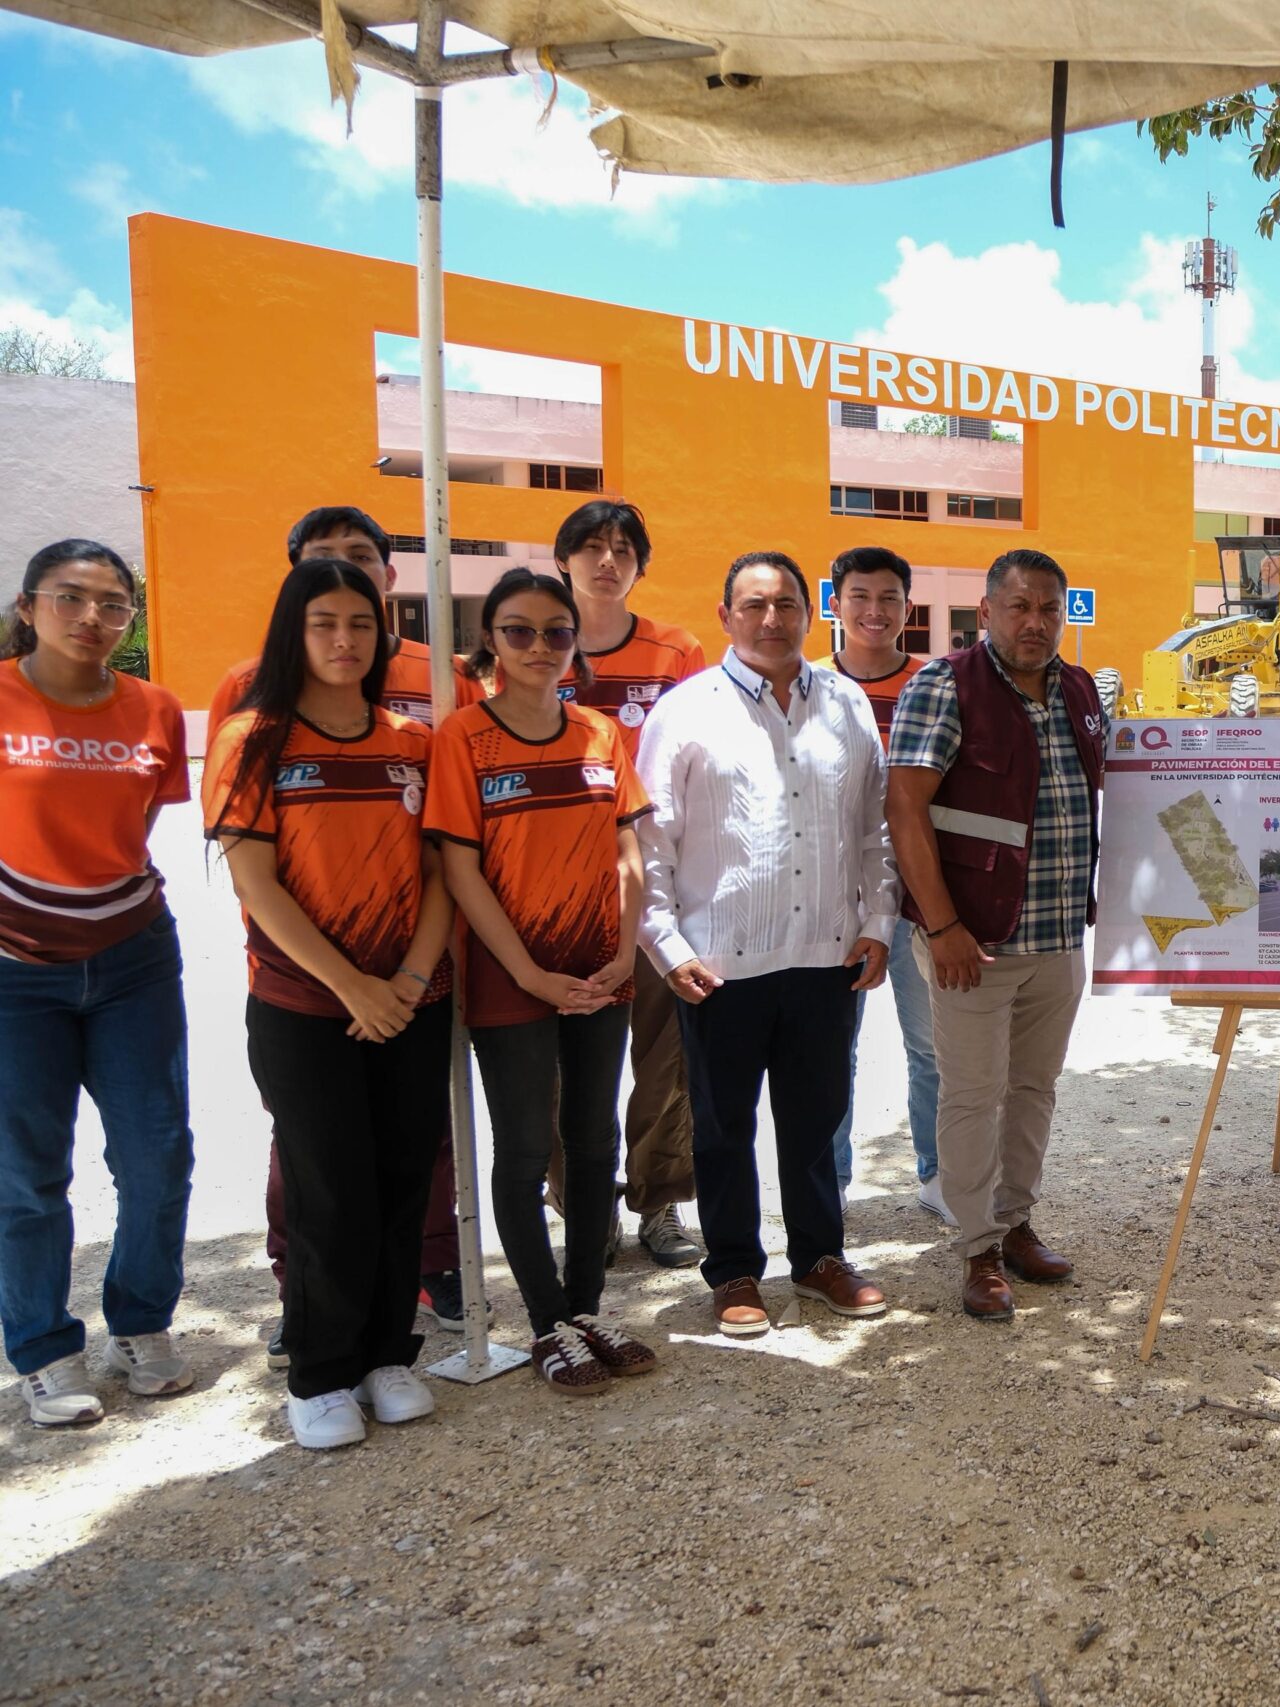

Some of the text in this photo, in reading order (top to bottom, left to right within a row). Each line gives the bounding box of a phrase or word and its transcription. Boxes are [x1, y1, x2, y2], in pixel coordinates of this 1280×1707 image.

[684, 319, 1059, 421] UNIVERSIDAD
[1196, 629, 1234, 650] ASFALKA
[1181, 729, 1209, 737] SEOP
[1216, 729, 1263, 738] IFEQROO
[4, 734, 154, 765] UPQROO
[1151, 759, 1247, 770] PAVIMENTACIÓN
[1249, 760, 1272, 769] DEL
[484, 772, 526, 797] UTP
